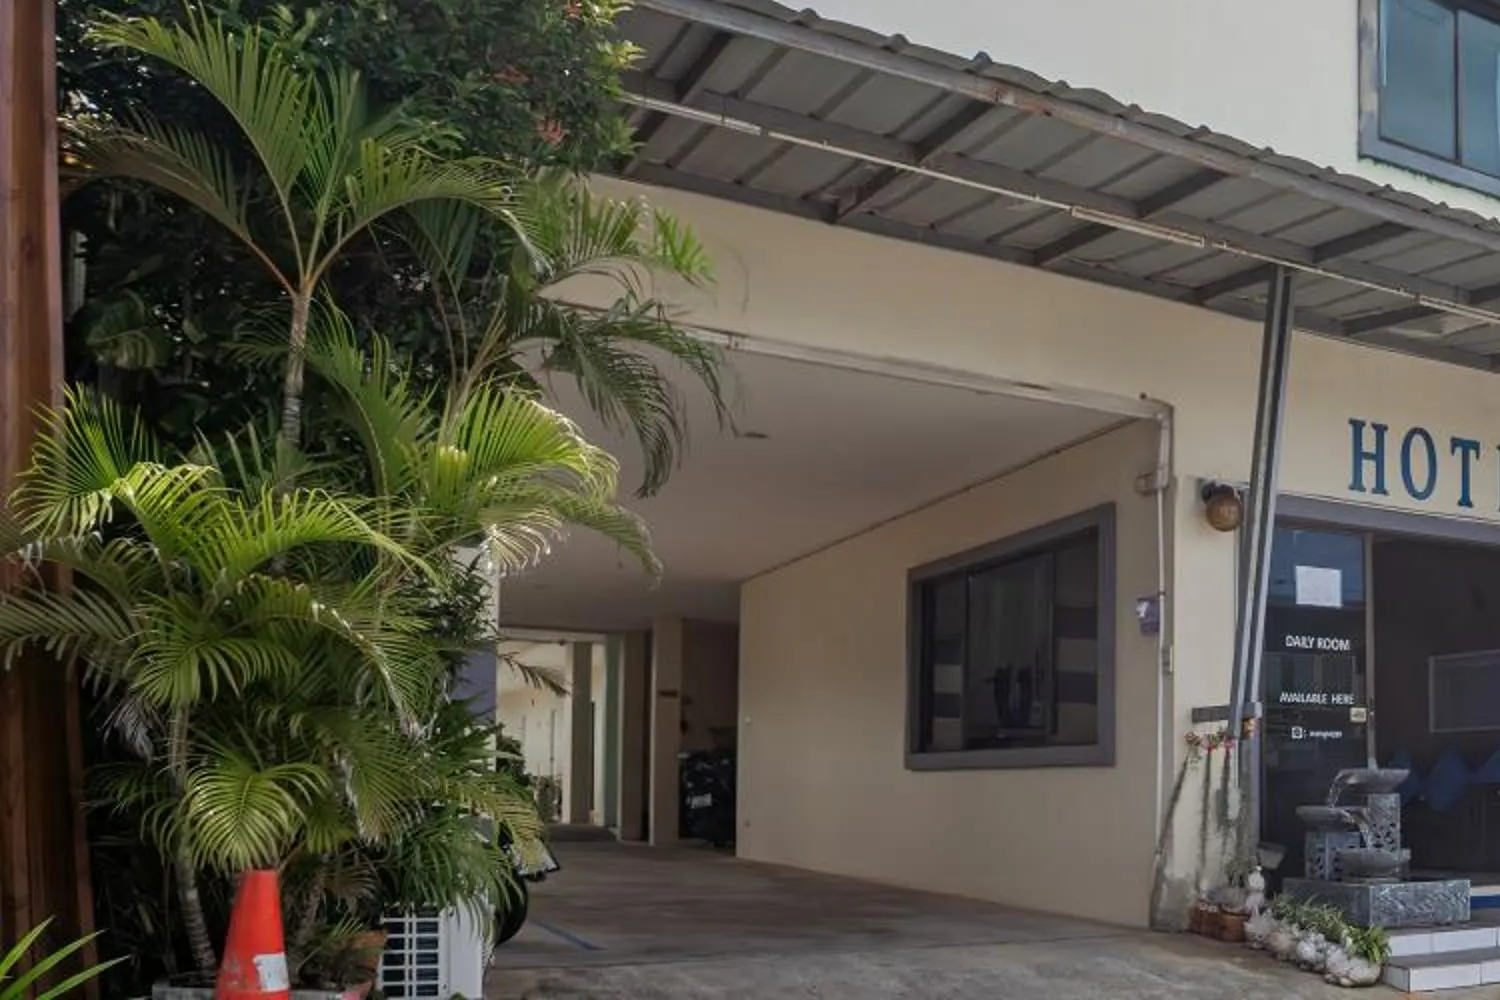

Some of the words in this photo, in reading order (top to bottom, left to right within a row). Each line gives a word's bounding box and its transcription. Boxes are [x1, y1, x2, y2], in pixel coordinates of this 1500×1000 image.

[1285, 635, 1315, 649] DAILY
[1317, 637, 1350, 651] ROOM
[1279, 692, 1328, 705] AVAILABLE
[1331, 693, 1355, 705] HERE
